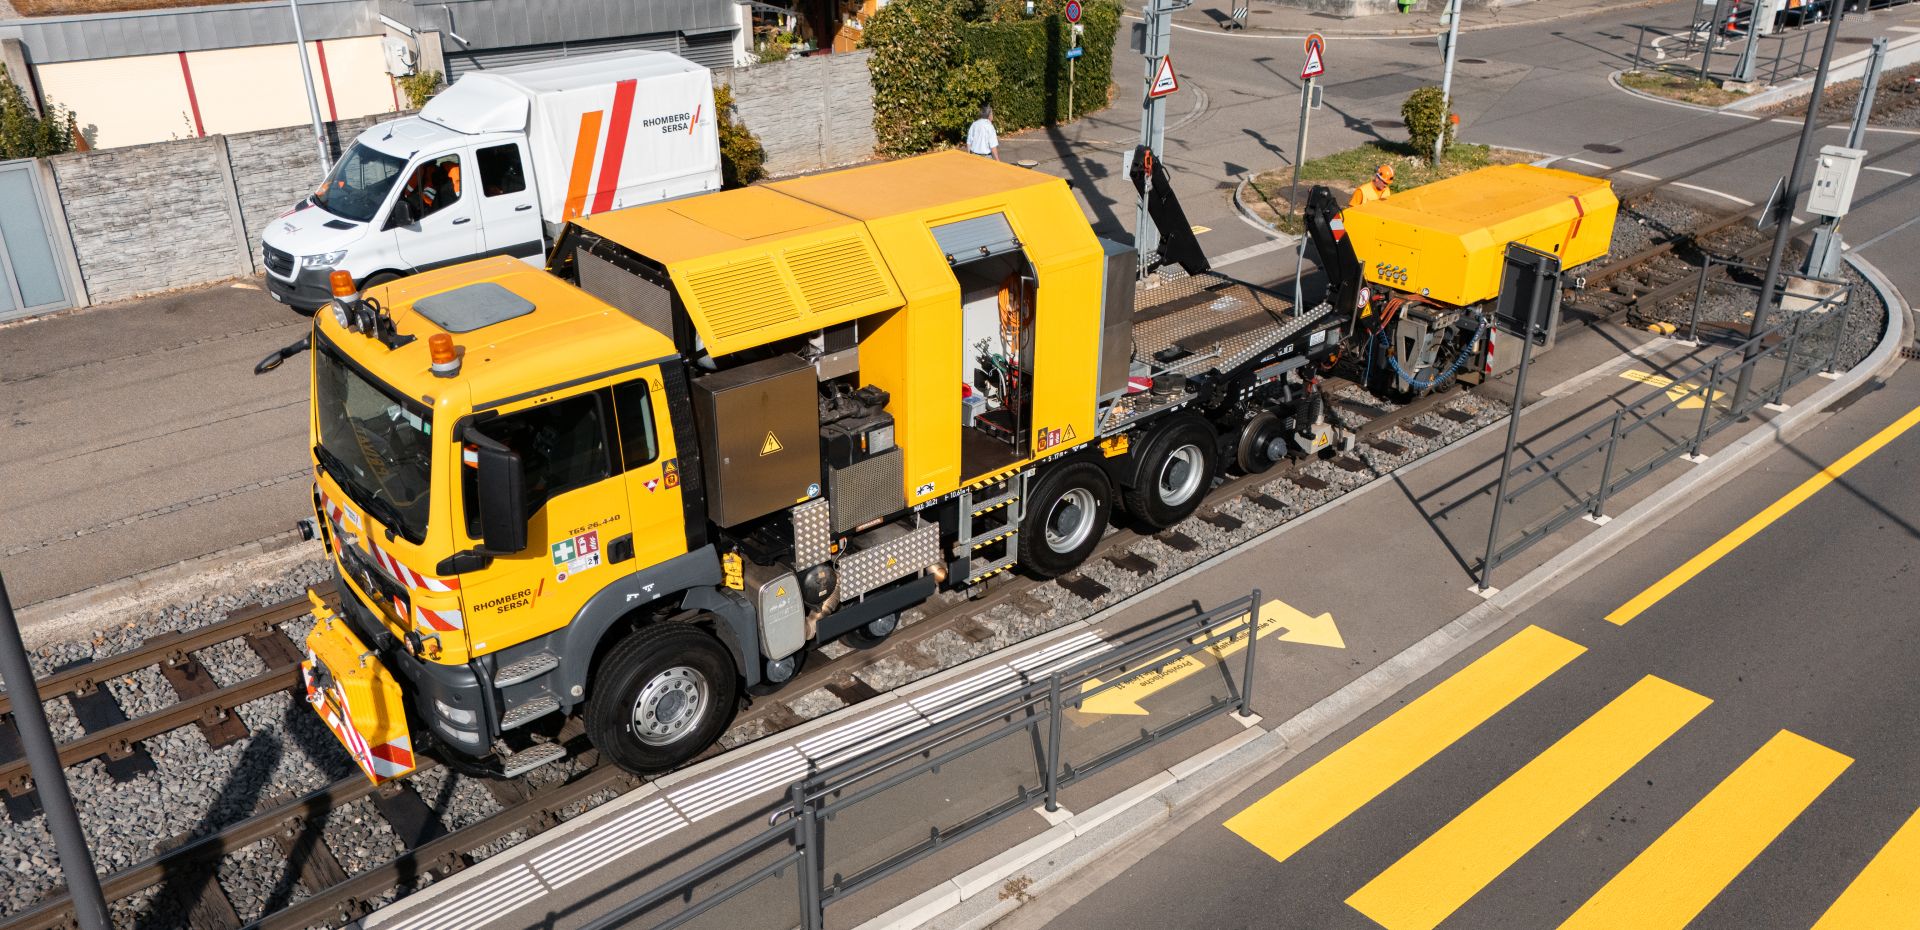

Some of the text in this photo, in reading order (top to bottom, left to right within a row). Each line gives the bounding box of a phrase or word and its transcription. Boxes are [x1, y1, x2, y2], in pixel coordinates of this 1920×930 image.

[643, 112, 690, 127] RHOMBERG
[662, 122, 688, 133] SERSA
[568, 514, 620, 535] TGS 26.440
[473, 588, 531, 612] RHOMBERG
[497, 598, 529, 614] SERSA
[1140, 660, 1193, 687] Provisorische
